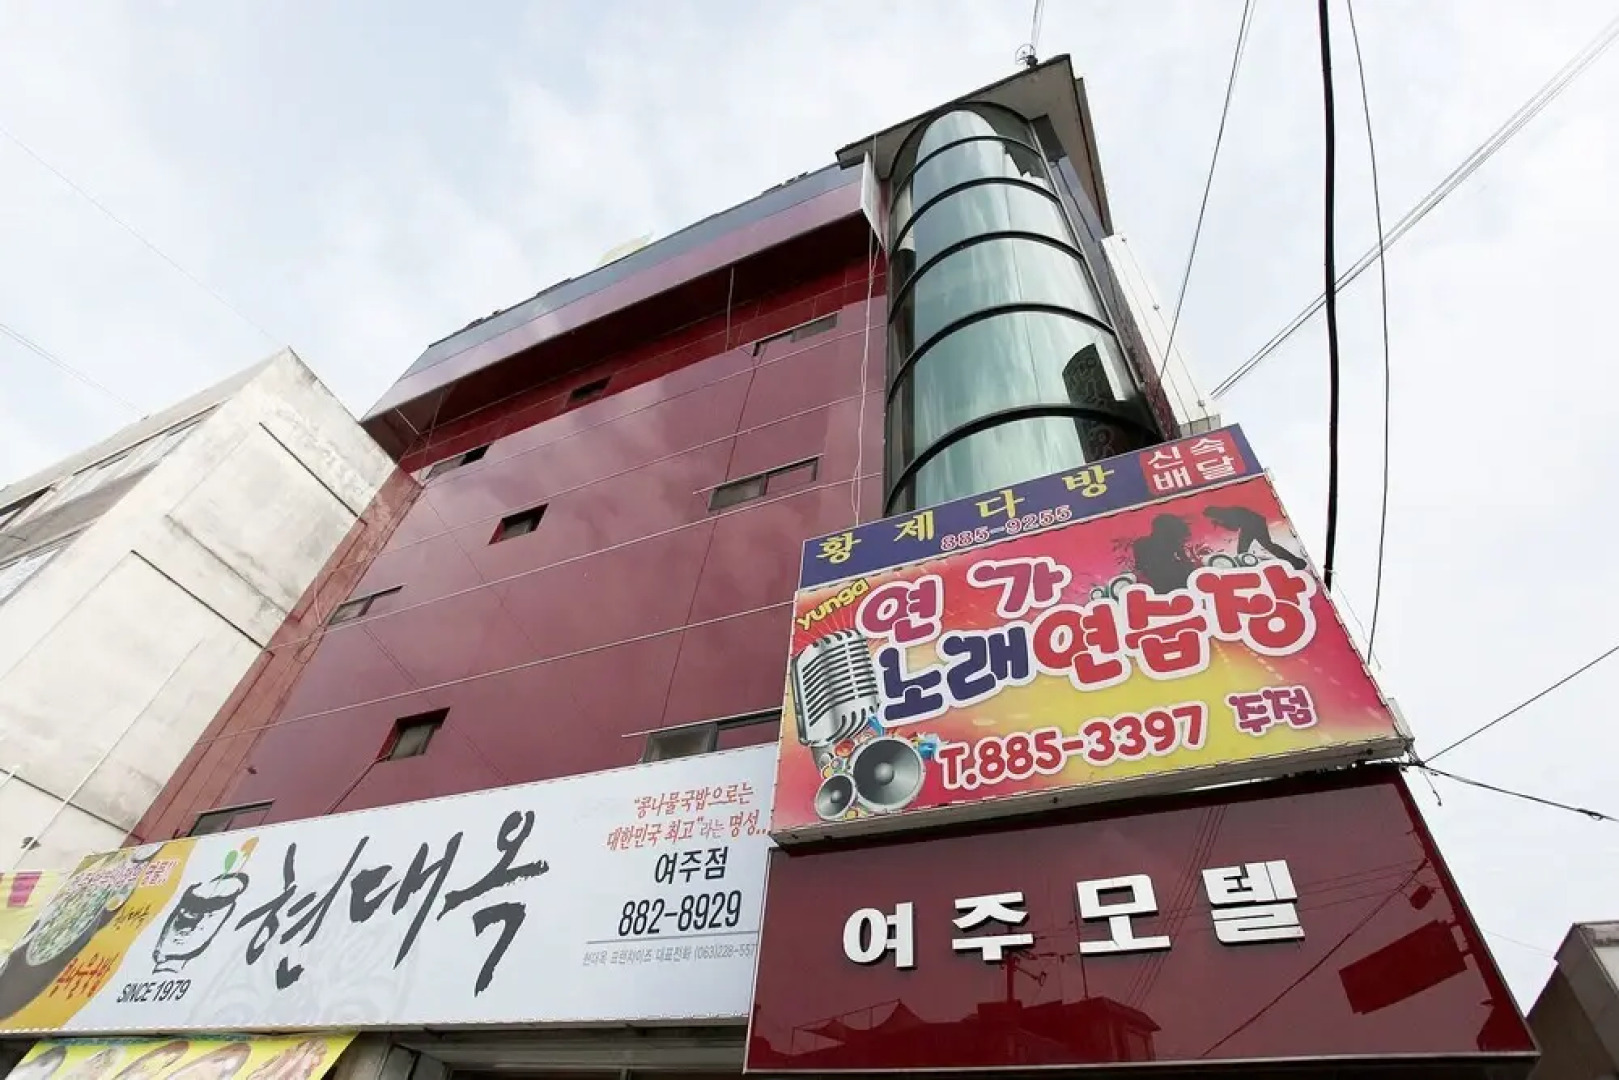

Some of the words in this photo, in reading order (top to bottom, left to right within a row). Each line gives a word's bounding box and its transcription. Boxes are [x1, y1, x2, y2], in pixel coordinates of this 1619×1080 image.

[1152, 454, 1236, 490] 배달
[940, 504, 1073, 551] 885-9255
[797, 578, 869, 631] yunga
[937, 702, 1209, 789] T.885-3397
[606, 822, 662, 850] 대한민국
[654, 846, 729, 885] 여주점
[617, 889, 742, 937] 882-8929
[116, 982, 156, 1003] SINCE
[153, 978, 192, 1002] 1979
